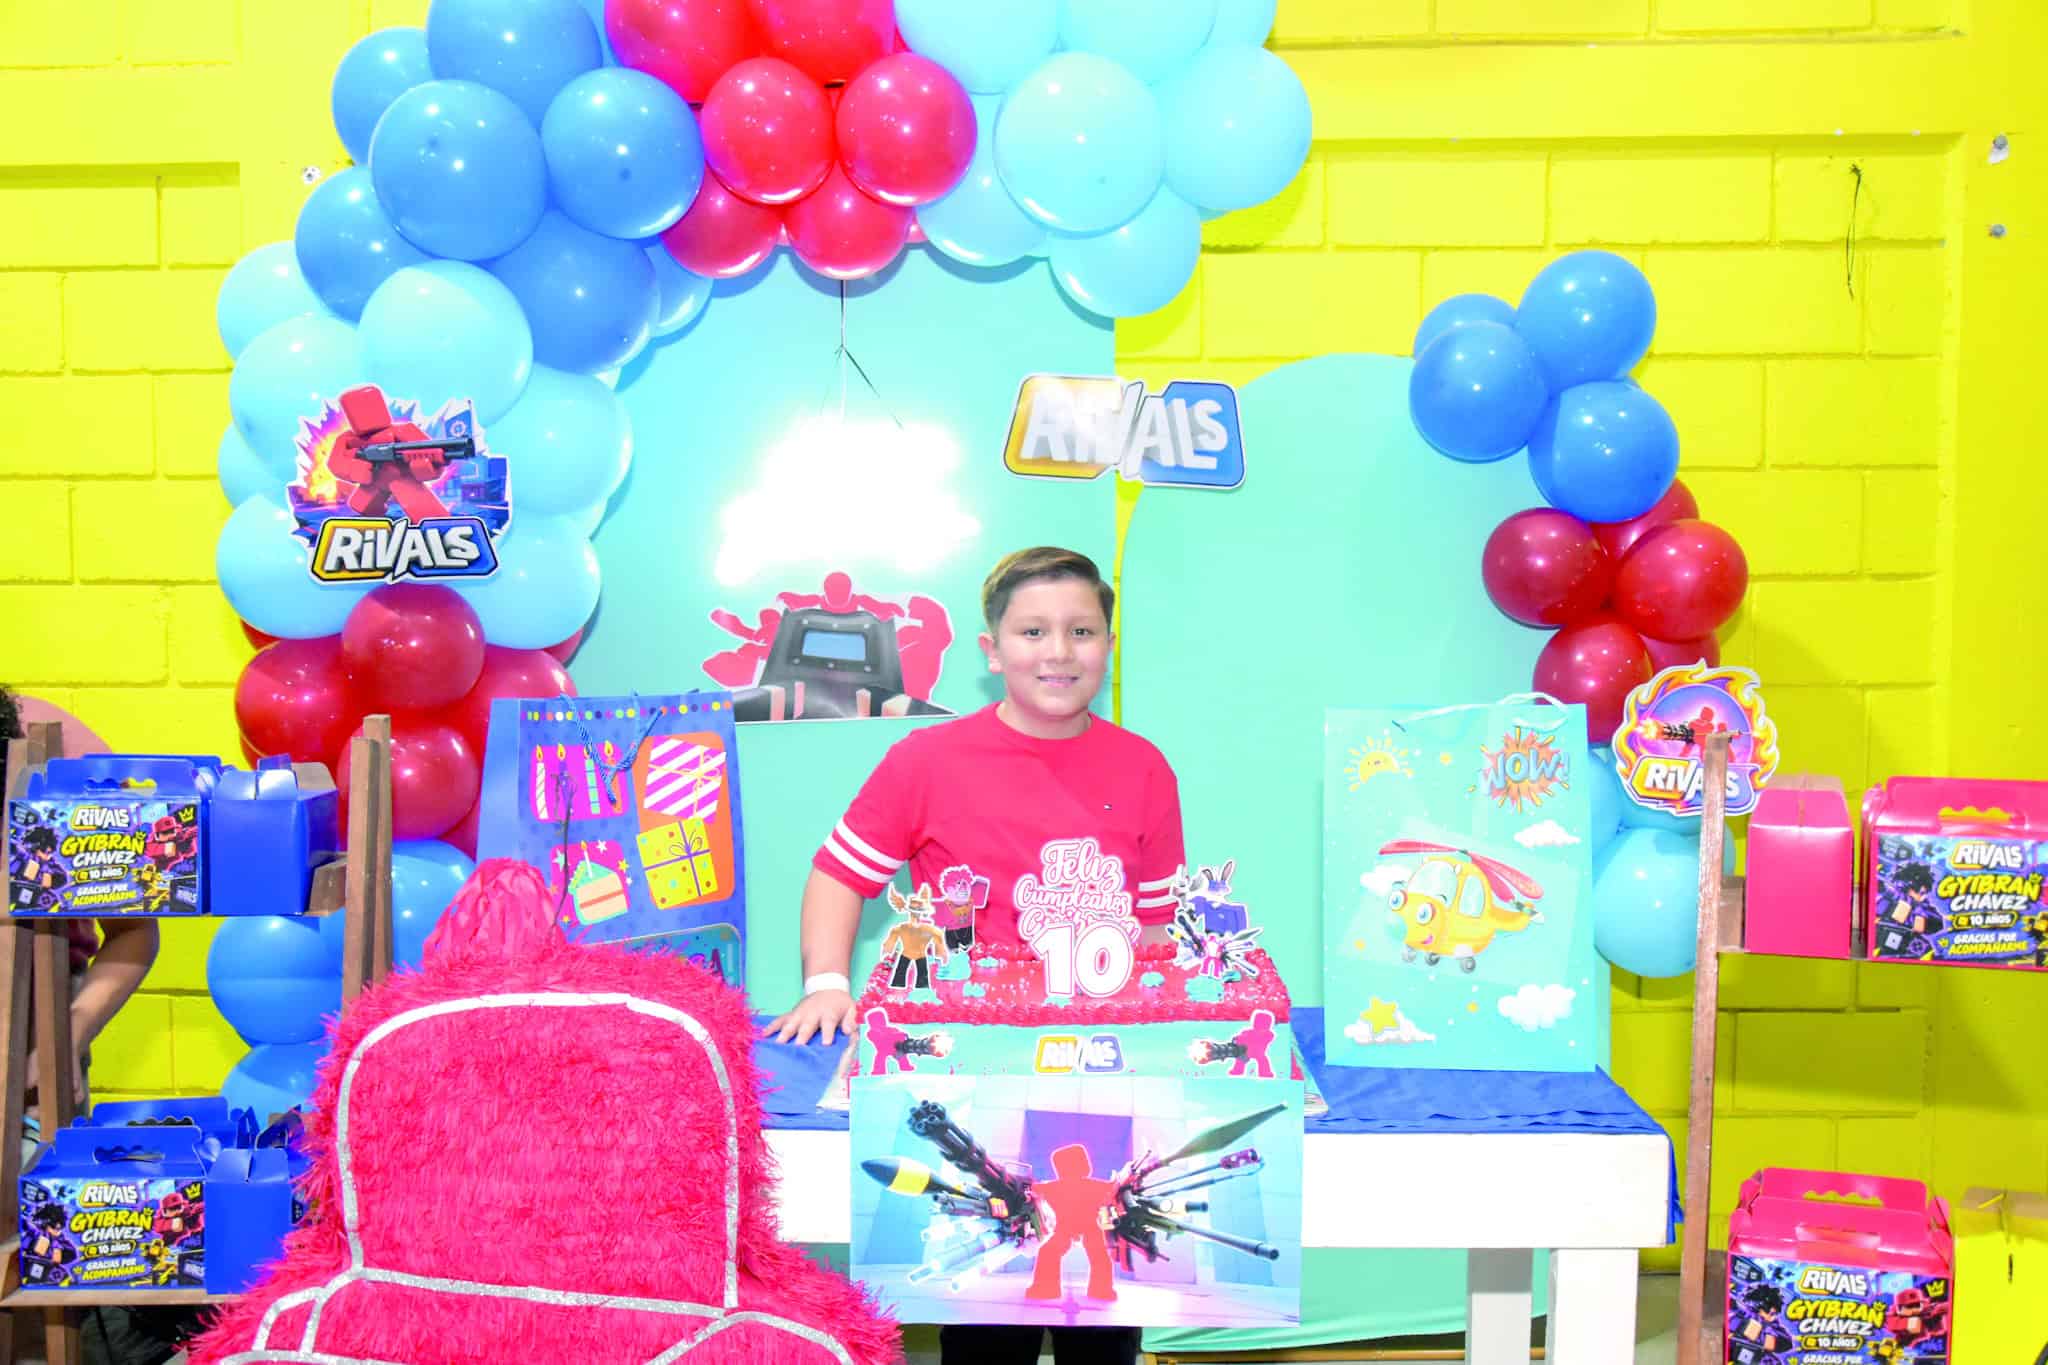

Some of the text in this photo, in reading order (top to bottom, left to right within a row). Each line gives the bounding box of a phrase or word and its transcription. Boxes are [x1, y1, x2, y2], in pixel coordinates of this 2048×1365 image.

[61, 834, 145, 856] GYIBRAN
[1043, 840, 1122, 892] Feliz
[1937, 874, 2040, 901] GYIBRAN
[1970, 915, 1983, 925] 10
[1032, 924, 1130, 995] 10
[70, 1210, 152, 1232] GYIBRAN
[1787, 1299, 1884, 1328] GYIBRAN
[1818, 1337, 1830, 1347] 10
